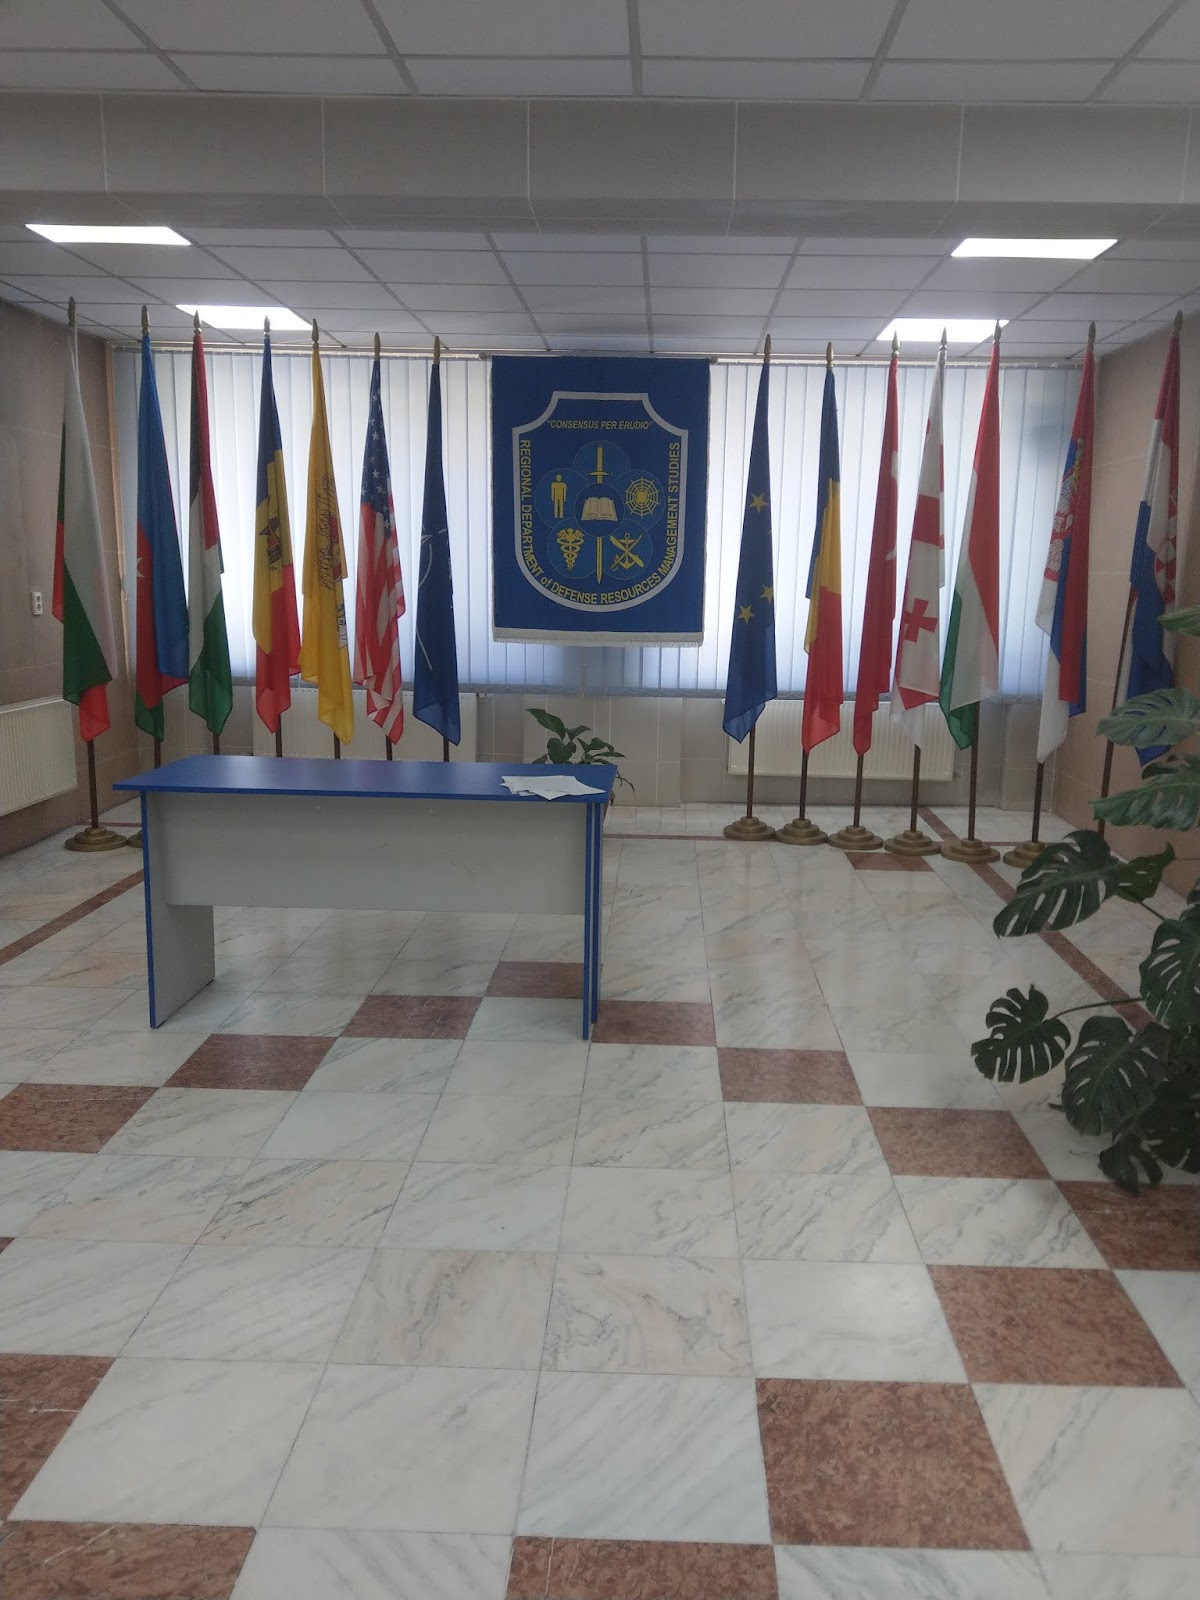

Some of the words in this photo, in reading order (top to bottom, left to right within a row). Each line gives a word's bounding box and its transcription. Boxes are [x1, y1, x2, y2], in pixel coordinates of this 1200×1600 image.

[600, 421, 619, 429] PER
[619, 421, 653, 430] ERUDIO"
[520, 440, 532, 501] REGIONAL
[668, 442, 680, 492] STUDIES
[521, 504, 544, 578] DEPARTMENT
[658, 496, 679, 576] MANAGEMENT
[540, 577, 553, 586] of
[550, 582, 598, 604] DEFENSE
[600, 572, 661, 604] RESOURCES
